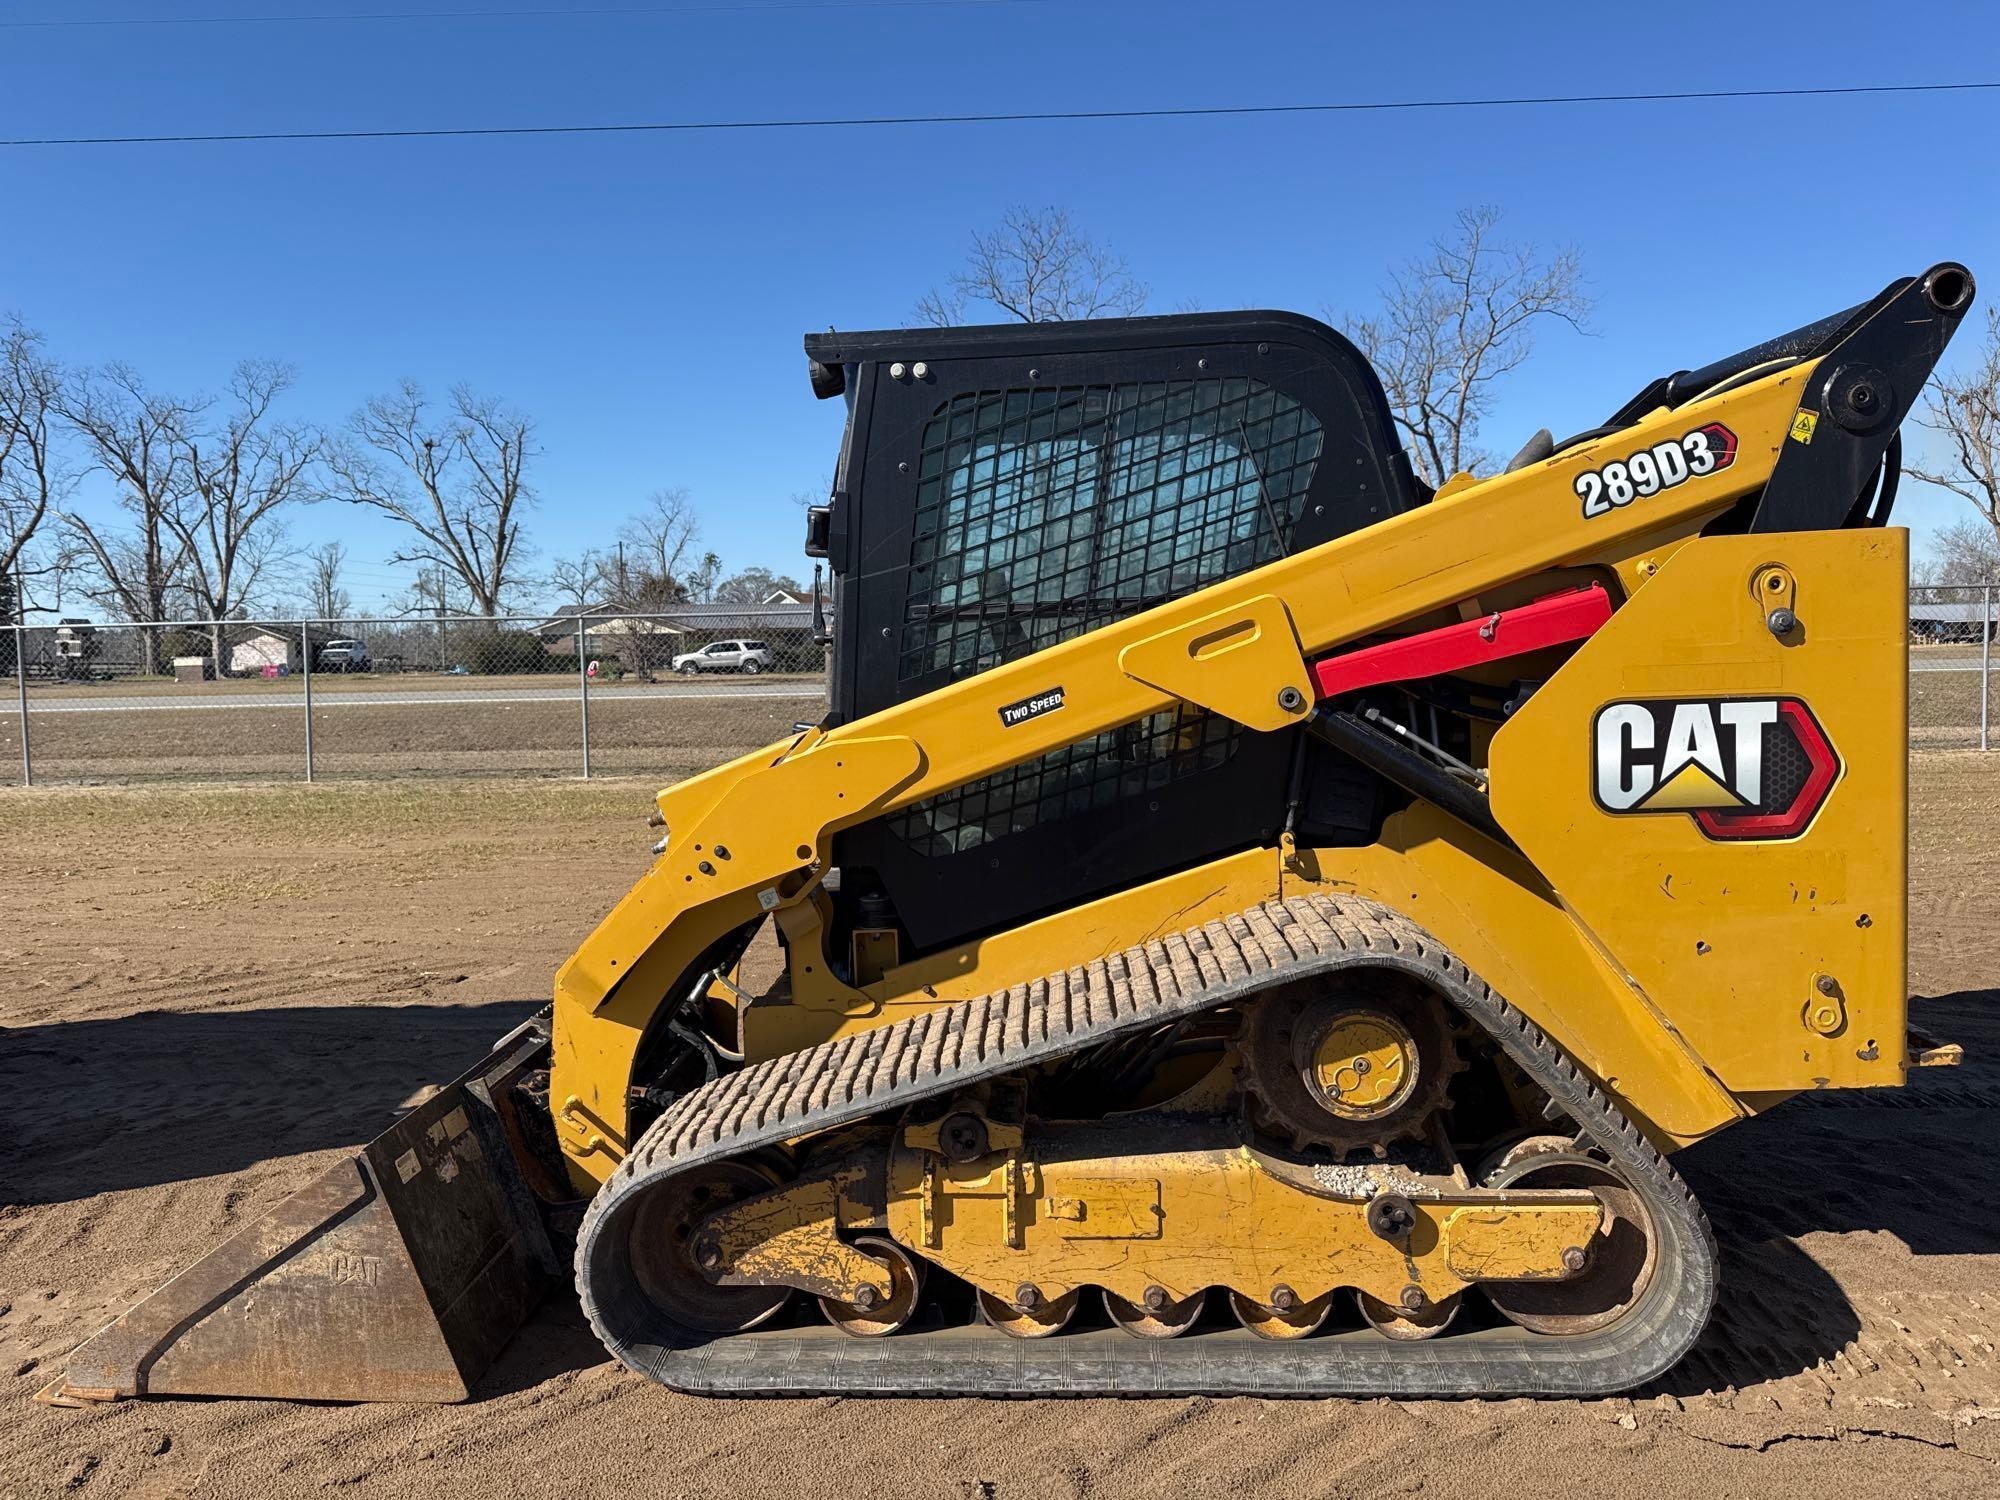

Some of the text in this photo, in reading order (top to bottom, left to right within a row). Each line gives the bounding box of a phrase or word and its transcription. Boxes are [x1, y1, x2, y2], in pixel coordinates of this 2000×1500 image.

[1576, 432, 1715, 517] 289D3
[1597, 701, 1777, 810] CAT
[329, 1254, 381, 1287] CAT
